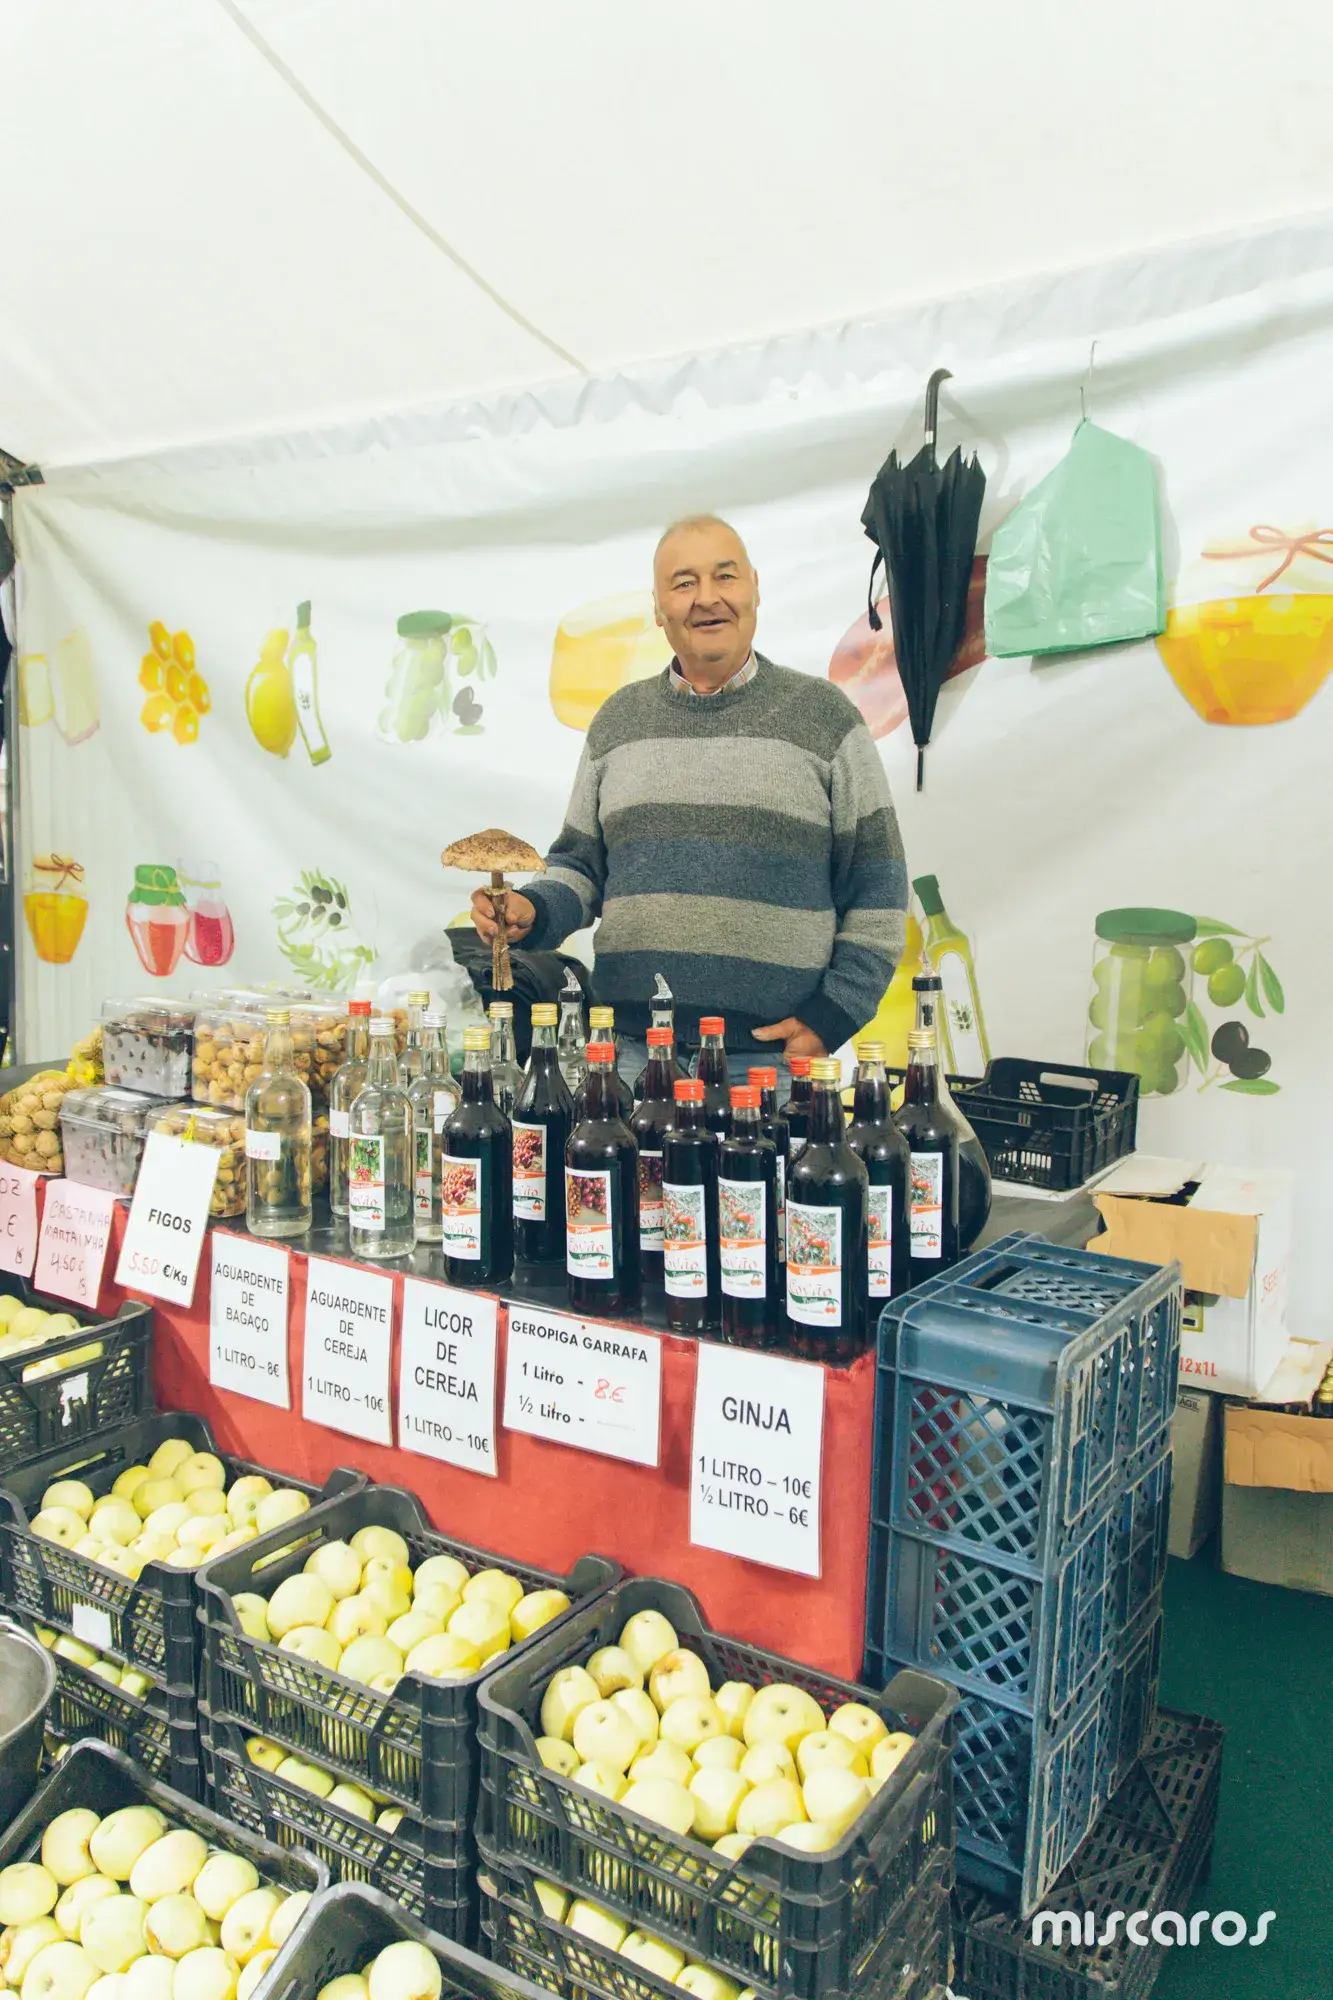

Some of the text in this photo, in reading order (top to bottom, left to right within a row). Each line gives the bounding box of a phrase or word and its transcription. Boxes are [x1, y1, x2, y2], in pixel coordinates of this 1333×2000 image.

[0, 1179, 21, 1197] OZ
[148, 1208, 192, 1234] FIGOS
[128, 1251, 188, 1286] 5.50 €/Kg
[215, 1262, 283, 1294] AGUARDENTE
[241, 1291, 255, 1307] DE
[310, 1290, 387, 1323] AGUARDENTE
[226, 1307, 269, 1333] BAGAÇO
[339, 1319, 354, 1336] DE
[425, 1306, 473, 1338] LICOR
[324, 1337, 368, 1363] CEREJA
[437, 1341, 458, 1365] DE
[511, 1320, 648, 1363] GEROPIGA GARRAFA
[216, 1346, 222, 1359] 1
[225, 1348, 255, 1370] LITRO
[267, 1361, 280, 1378] 8€
[522, 1362, 528, 1376] 1
[534, 1365, 564, 1385] Litro
[308, 1376, 314, 1390] 1
[317, 1378, 350, 1402] LITRO
[364, 1394, 384, 1413] 10€
[414, 1366, 479, 1403] CEREJA
[540, 1402, 571, 1424] Litro
[722, 1396, 792, 1434] GINJA
[404, 1414, 411, 1429] 1
[415, 1417, 452, 1442] LITRO
[467, 1434, 489, 1453] 10€
[699, 1456, 706, 1473] 1
[712, 1458, 762, 1486] LITRO
[783, 1475, 811, 1499] 10€
[719, 1488, 769, 1517] LITRO
[789, 1506, 809, 1527] 6€
